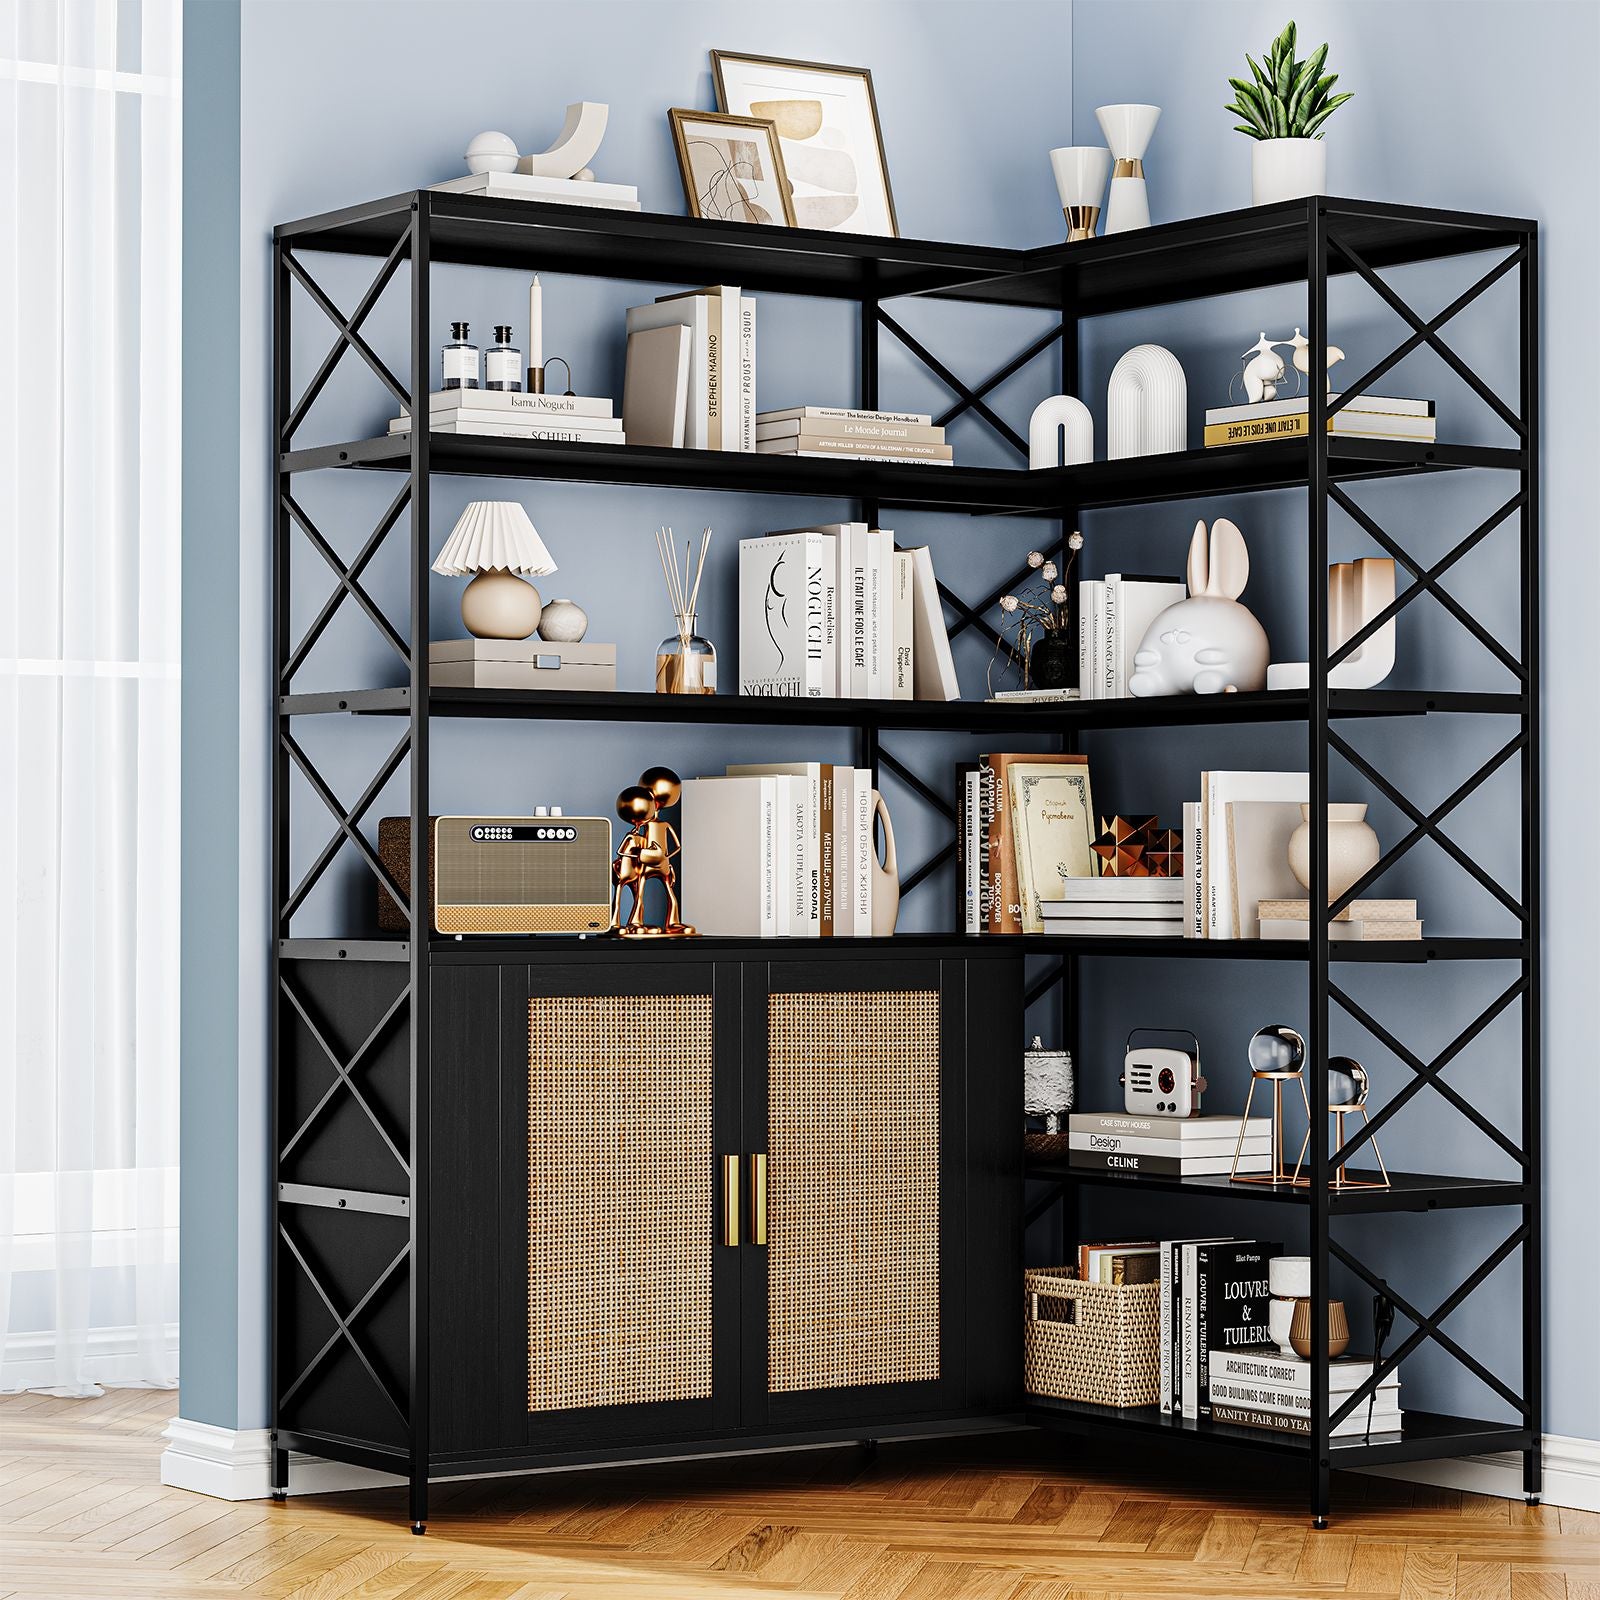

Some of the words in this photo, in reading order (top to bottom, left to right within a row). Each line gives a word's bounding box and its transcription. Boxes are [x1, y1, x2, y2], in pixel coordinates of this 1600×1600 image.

[743, 311, 751, 338] SQUID
[709, 334, 717, 372] MARINO
[743, 358, 751, 393] PROUST
[511, 396, 536, 408] Isamu
[538, 398, 575, 412] Noguchi
[709, 374, 717, 417] STEPHEN
[875, 414, 893, 422] Design
[1265, 421, 1277, 433] UNE
[1295, 418, 1300, 430] IL
[844, 425, 854, 433] Le
[855, 426, 880, 436] Monde
[881, 428, 908, 438] Journal
[1228, 427, 1242, 441] CAFÉ
[1243, 425, 1250, 436] LE
[1251, 423, 1264, 436] FOIS
[855, 576, 866, 598] ÉTAIT
[808, 567, 822, 659] NOGUCHI
[826, 586, 834, 644] Remodelista
[855, 600, 864, 616] UNE
[855, 618, 864, 635] FOIS
[855, 636, 864, 646] LE
[855, 648, 866, 668] CAFÉ
[896, 646, 905, 688] Chipperfield
[744, 682, 800, 697] NOGUCHI
[860, 790, 868, 832] НОВЫЙ
[796, 803, 804, 841] ЗАБОТА
[796, 844, 804, 852] О
[860, 835, 868, 870] ОБРАЗ
[796, 854, 804, 916] ПРЕДАННЫХ
[994, 872, 1002, 896] BOOK
[810, 870, 818, 920] ШОКОЛАД
[824, 888, 832, 921] ЛУЧШЕ
[860, 874, 868, 915] ЖИЗНИ
[994, 896, 1002, 922] COVER
[1100, 1119, 1114, 1127] CASE
[1114, 1120, 1130, 1128] STUDY
[1130, 1122, 1151, 1130] HOUSES
[1091, 1135, 1121, 1151] Design
[1107, 1156, 1139, 1169] CELINE
[1236, 1254, 1246, 1262] Eliot
[1224, 1280, 1269, 1300] LOUVRE
[1242, 1304, 1252, 1322] &
[1163, 1338, 1170, 1347] &
[1226, 1360, 1268, 1378] ARCHITECTURE
[1269, 1364, 1296, 1382] CORRECT
[1212, 1384, 1227, 1398] GOOD
[1228, 1386, 1258, 1403] BUILDINGS
[1259, 1390, 1276, 1404] COME
[1277, 1392, 1294, 1407] FROM
[1214, 1407, 1250, 1424] VANITY
[1251, 1410, 1272, 1426] FAIR
[1274, 1414, 1289, 1428] 100
